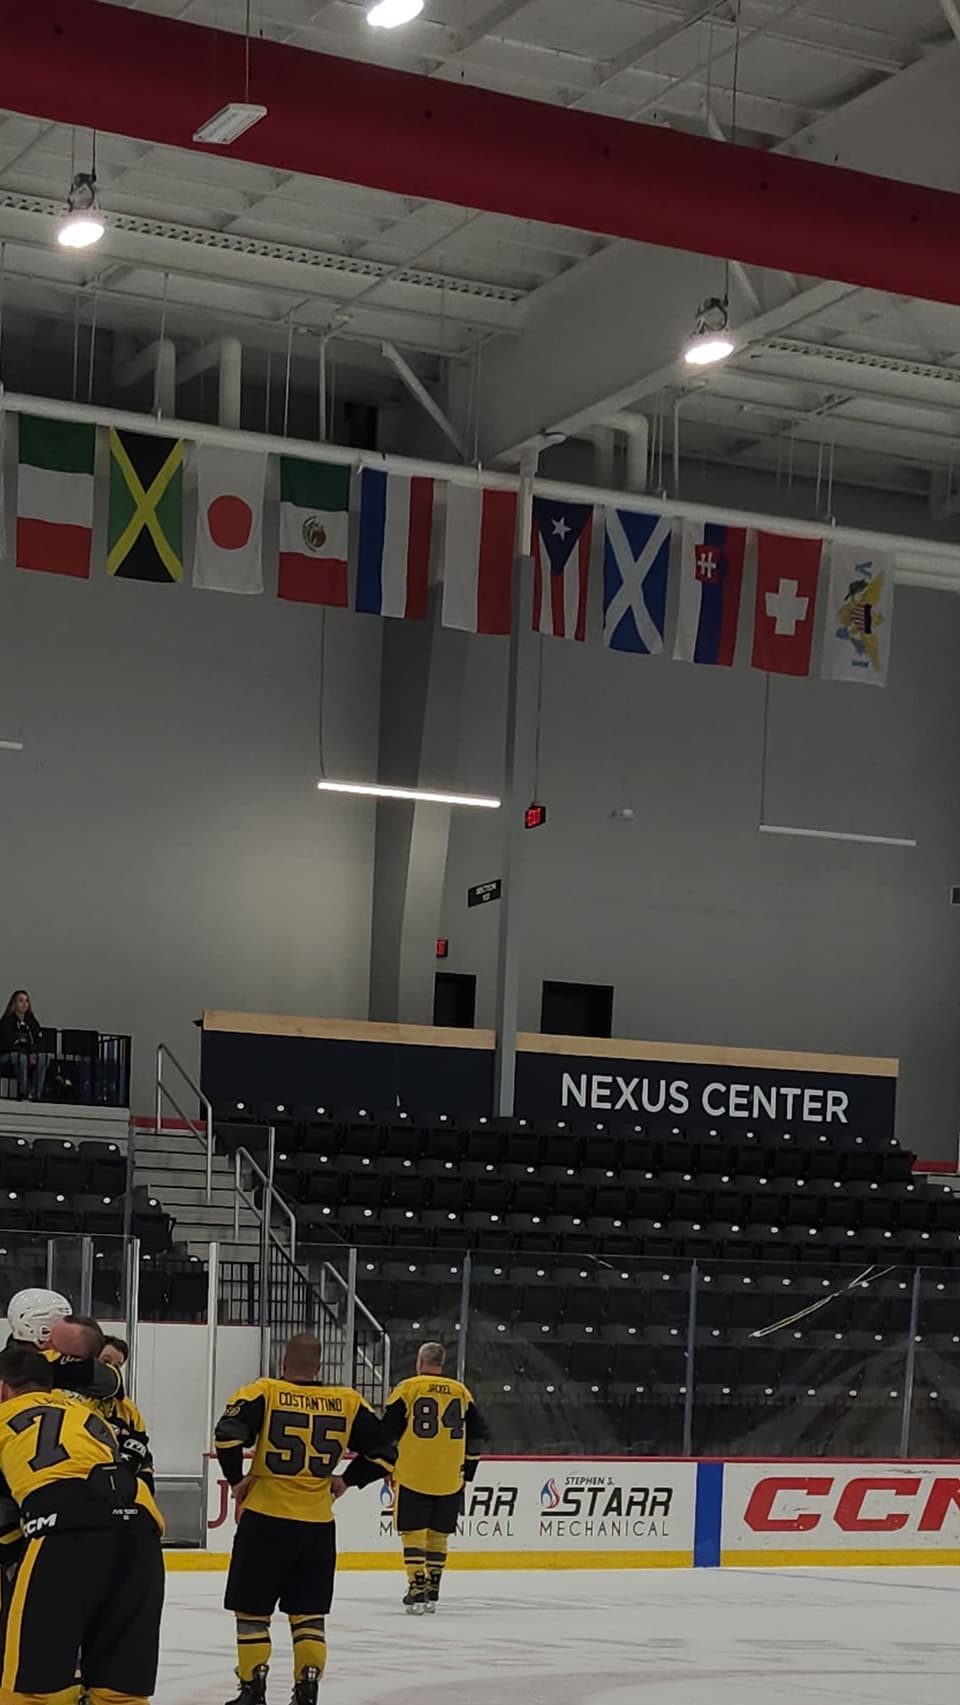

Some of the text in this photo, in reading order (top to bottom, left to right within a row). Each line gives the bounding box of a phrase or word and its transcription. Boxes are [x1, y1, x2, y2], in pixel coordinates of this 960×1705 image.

[561, 1072, 849, 1123] NEXUS CENTER
[279, 1391, 343, 1412] COSTANTINO
[412, 1396, 464, 1440] 84
[264, 1409, 347, 1478] 55
[565, 1476, 605, 1486] STEPHEN
[540, 1487, 673, 1517] STARR
[539, 1521, 669, 1537] MECHANICAL
